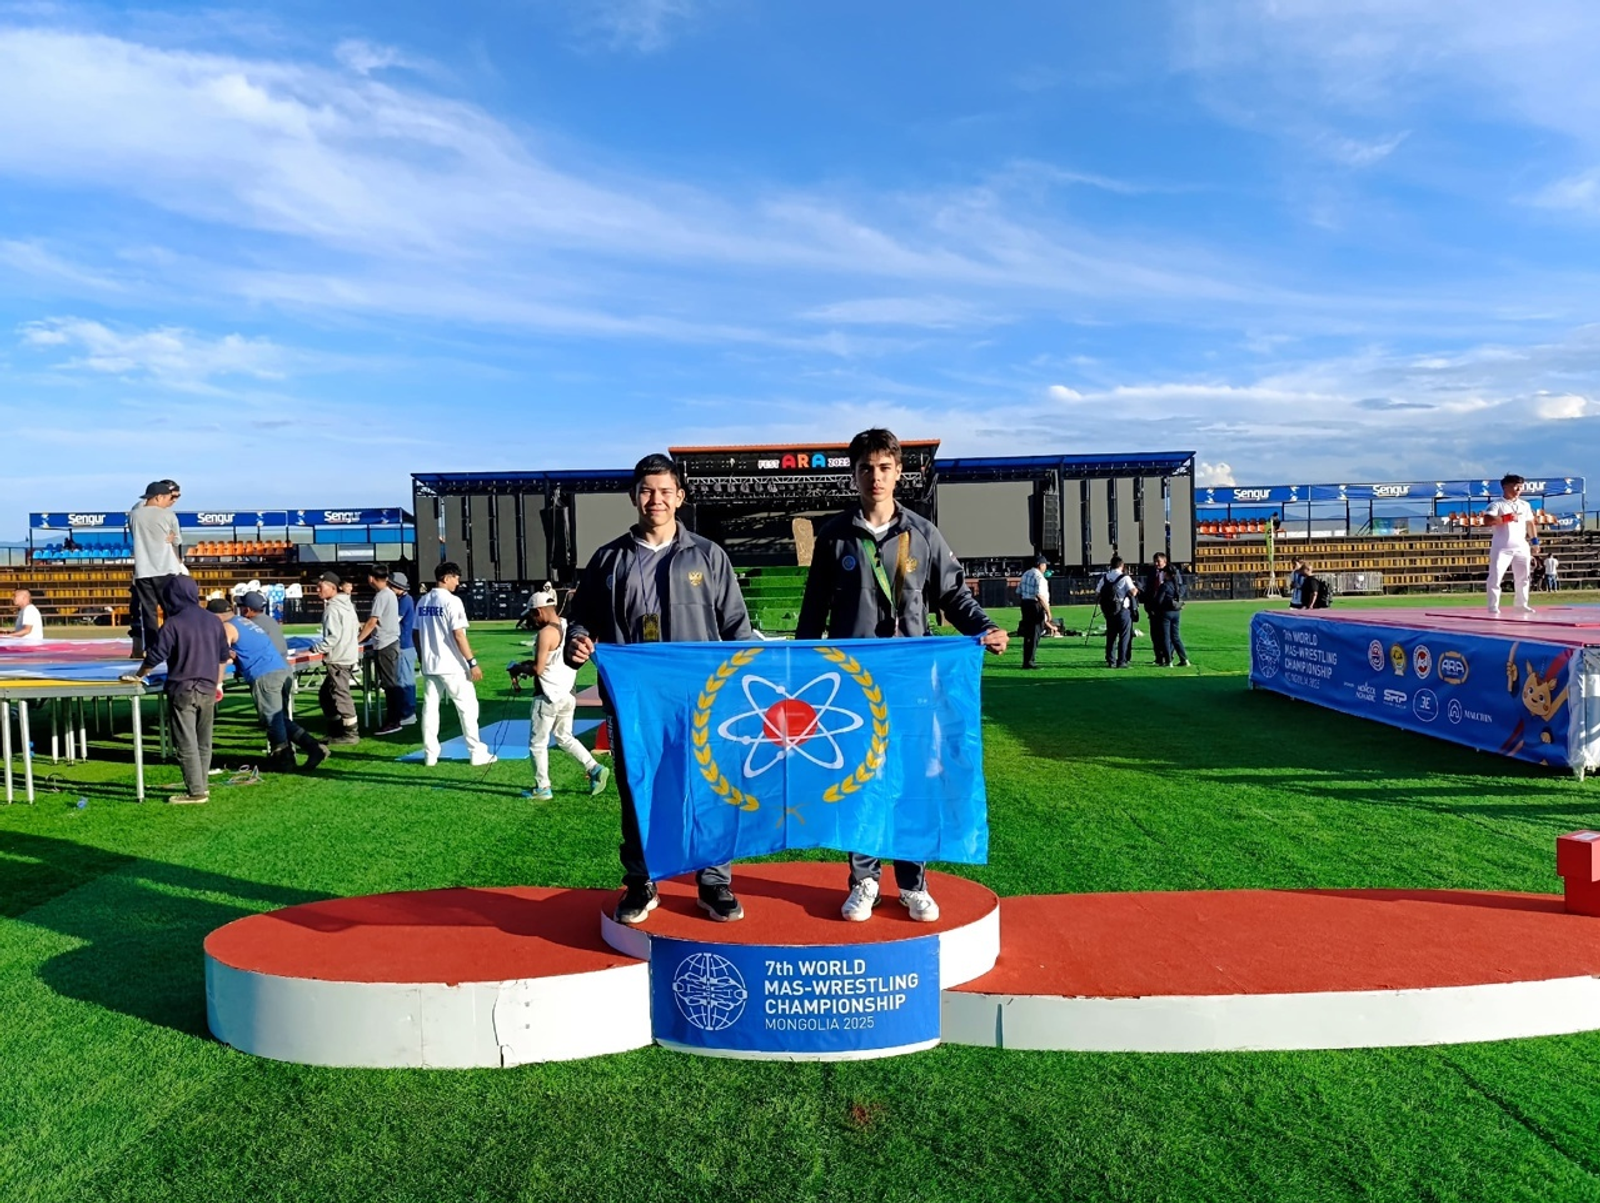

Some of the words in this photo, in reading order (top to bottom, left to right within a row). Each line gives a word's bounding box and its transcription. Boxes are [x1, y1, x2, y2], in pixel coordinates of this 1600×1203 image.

[757, 459, 780, 470] FEST
[781, 453, 826, 468] ARA
[827, 457, 851, 467] 2025
[1233, 488, 1271, 501] Sengur
[1372, 484, 1411, 497] Sengur
[1522, 481, 1546, 493] ngur
[67, 512, 106, 526] Sengur
[197, 512, 235, 525] Sengur
[324, 510, 362, 524] Sengur
[1292, 631, 1319, 646] WORLD
[1284, 643, 1337, 666] MAS-WRESTLING
[1284, 657, 1332, 679] CHAMPIONSHIP
[1441, 659, 1464, 673] ARA
[765, 960, 793, 976] 7th
[799, 959, 866, 976] WORLD
[764, 973, 919, 996] MAS-WRESTLING
[765, 994, 906, 1015] CHAMPIONSHIP
[765, 1017, 840, 1031] MONGOLIA
[843, 1016, 875, 1030] 2025
